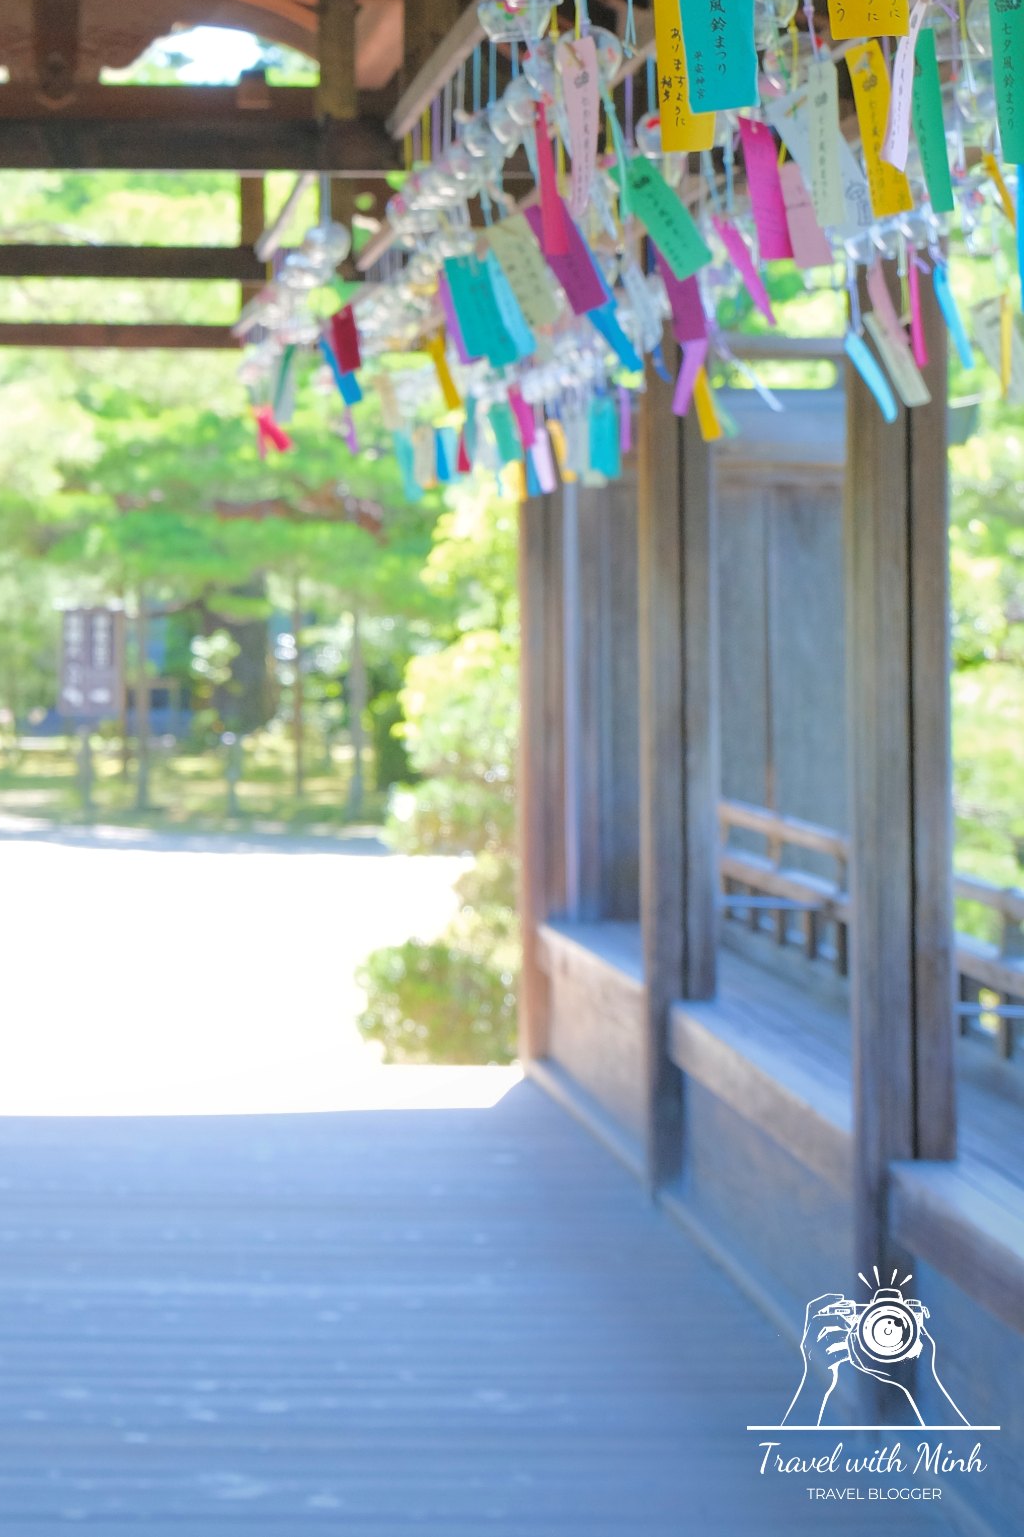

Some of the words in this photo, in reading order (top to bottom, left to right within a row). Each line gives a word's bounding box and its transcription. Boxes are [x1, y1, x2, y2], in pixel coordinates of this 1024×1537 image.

[1000, 22, 1015, 129] 七夕風鈴まつり
